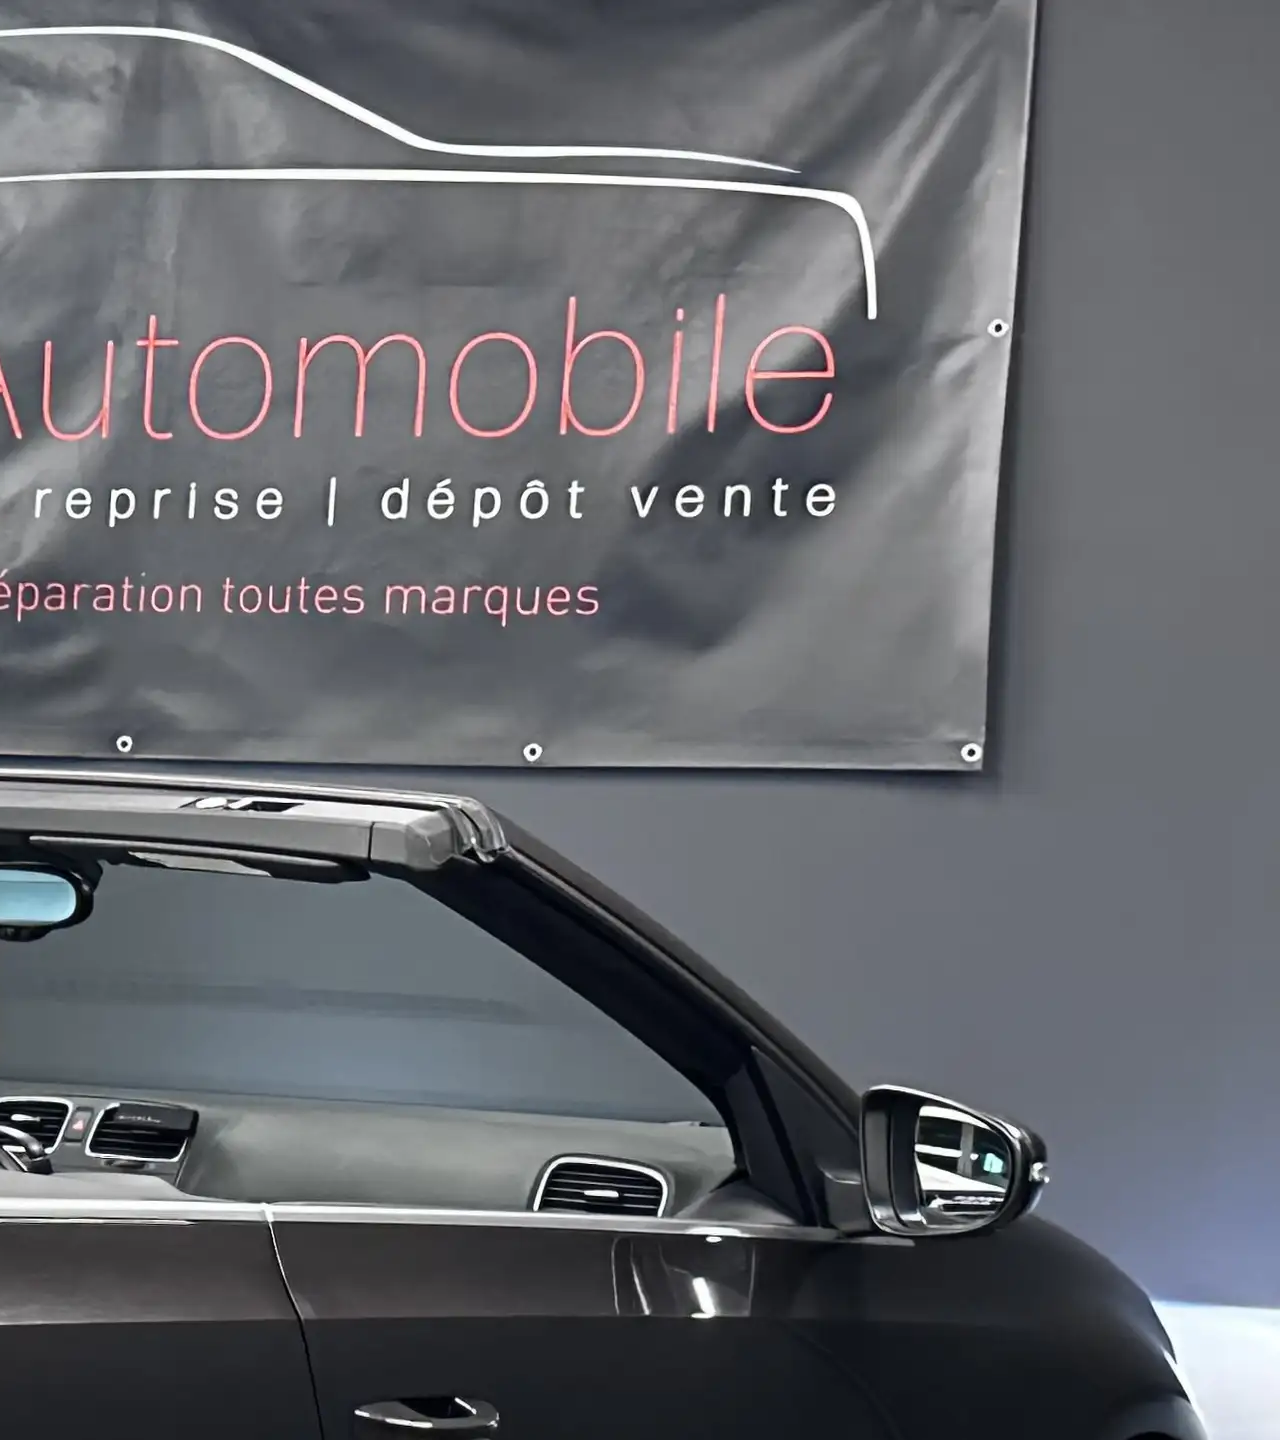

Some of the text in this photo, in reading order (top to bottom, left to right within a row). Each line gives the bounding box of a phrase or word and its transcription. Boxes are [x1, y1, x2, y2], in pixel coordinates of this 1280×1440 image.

[33, 480, 283, 527] reprise
[381, 477, 586, 528] dépôt
[630, 477, 836, 518] vente
[222, 576, 366, 616] toutes
[384, 580, 600, 627] marques
